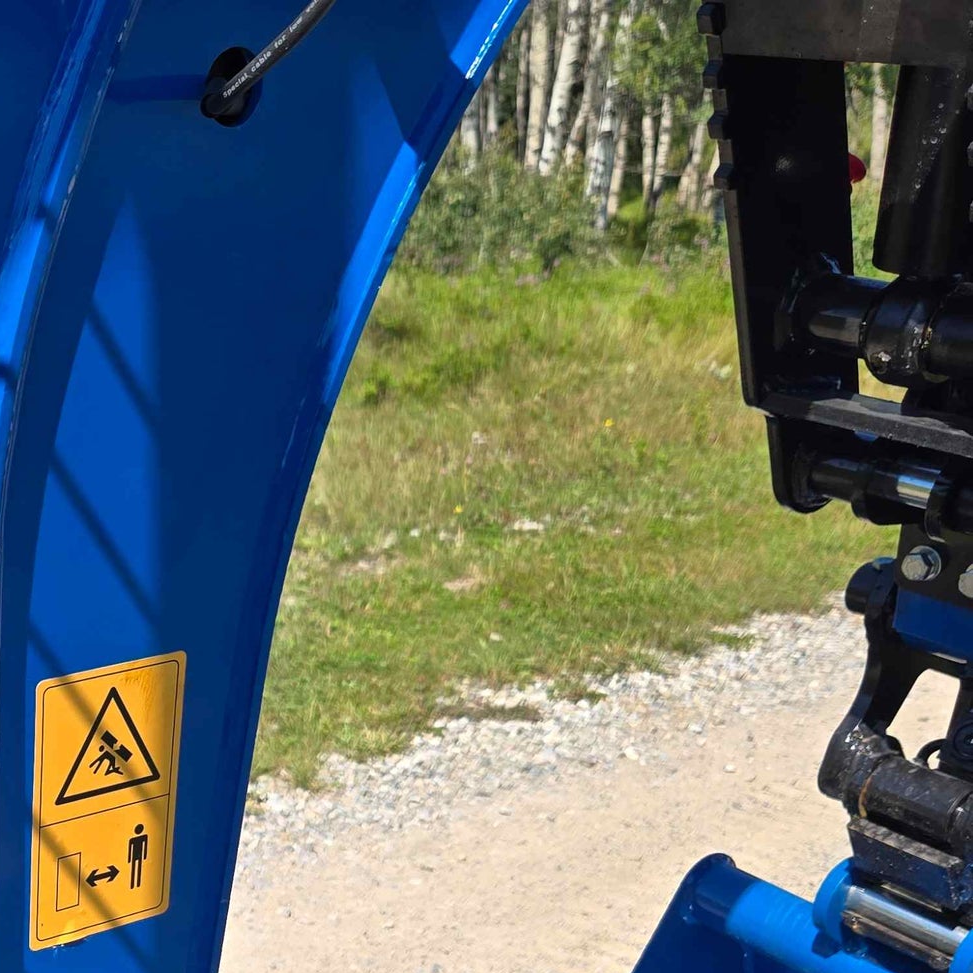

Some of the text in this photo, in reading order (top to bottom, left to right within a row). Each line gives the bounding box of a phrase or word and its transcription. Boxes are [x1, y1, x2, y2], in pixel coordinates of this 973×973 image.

[222, 73, 249, 98] Special
[251, 50, 272, 73] cable
[274, 34, 287, 49] for
[289, 16, 303, 33] low
